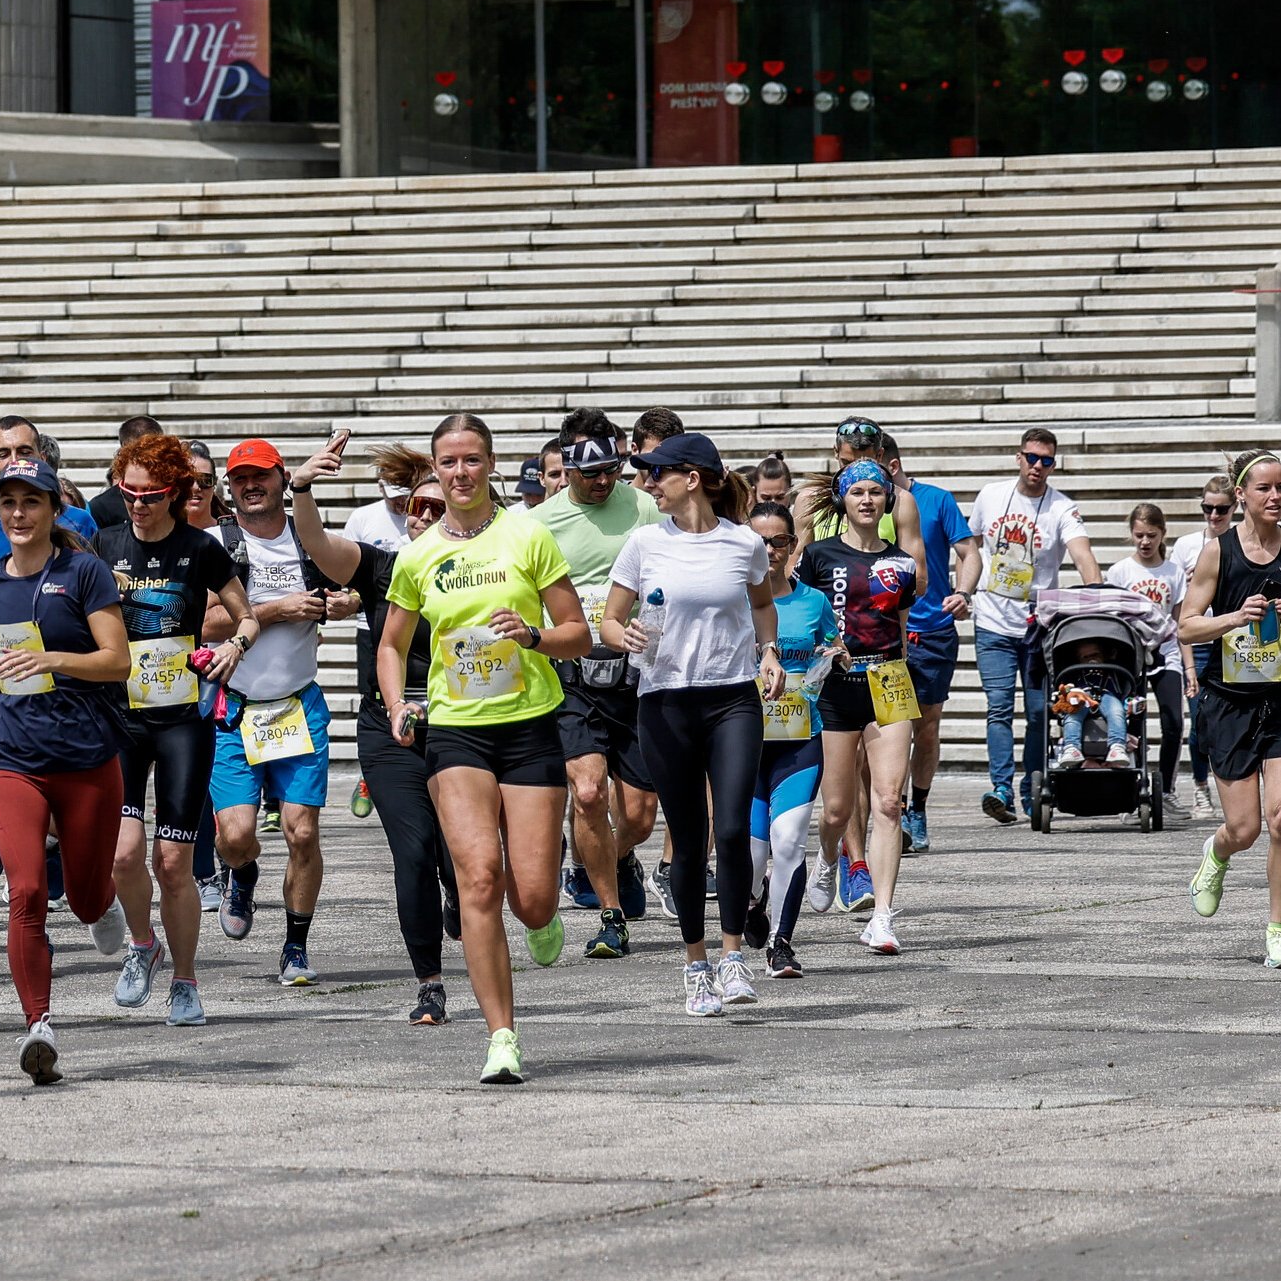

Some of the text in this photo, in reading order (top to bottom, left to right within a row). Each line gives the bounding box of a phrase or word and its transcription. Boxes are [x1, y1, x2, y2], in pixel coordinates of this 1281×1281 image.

[1232, 651, 1276, 663] 158585
[458, 658, 504, 676] 29192
[141, 668, 183, 685] 84557
[766, 704, 803, 717] 23070
[252, 725, 299, 742] 128042
